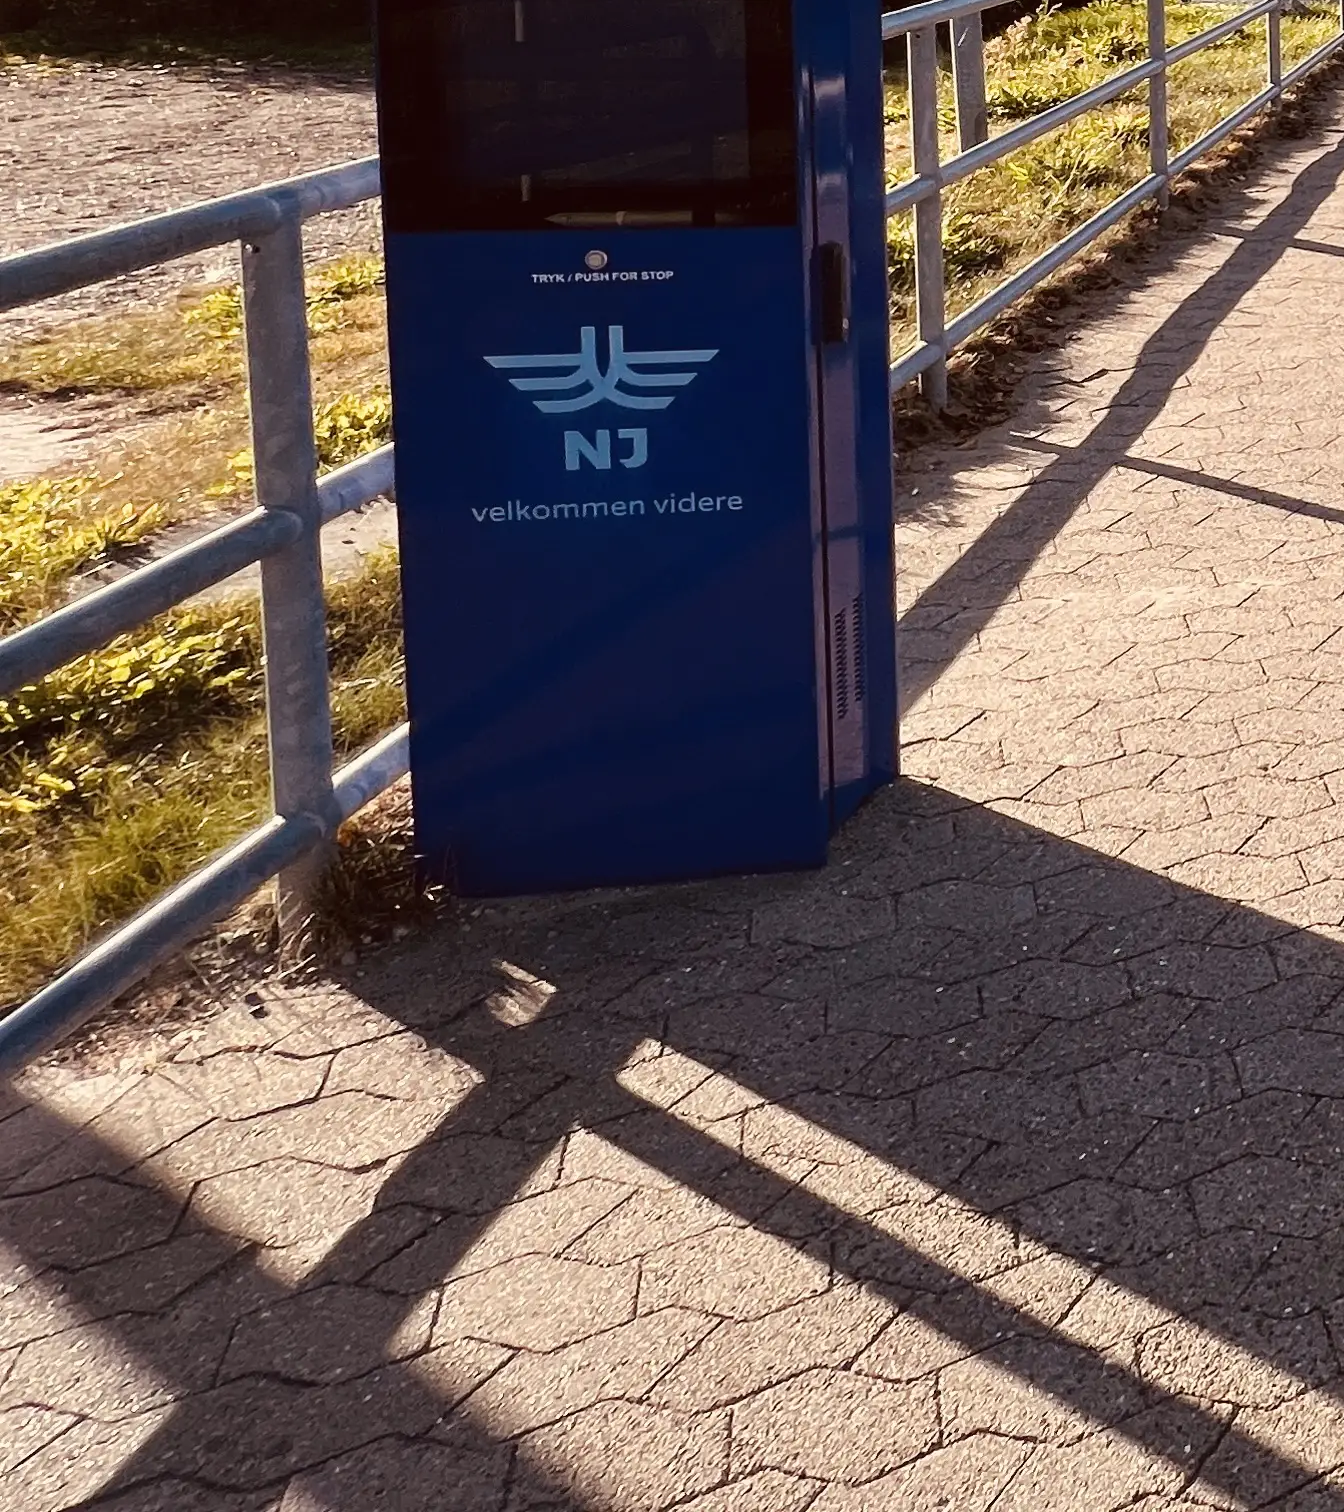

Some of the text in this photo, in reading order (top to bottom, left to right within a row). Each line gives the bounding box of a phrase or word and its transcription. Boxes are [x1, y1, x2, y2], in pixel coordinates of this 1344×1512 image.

[531, 273, 565, 284] TRYK
[575, 272, 610, 283] PUSH
[612, 271, 638, 282] FOR
[641, 270, 675, 281] STOP
[563, 427, 650, 471] NJ
[471, 491, 744, 523] velkommen videre
